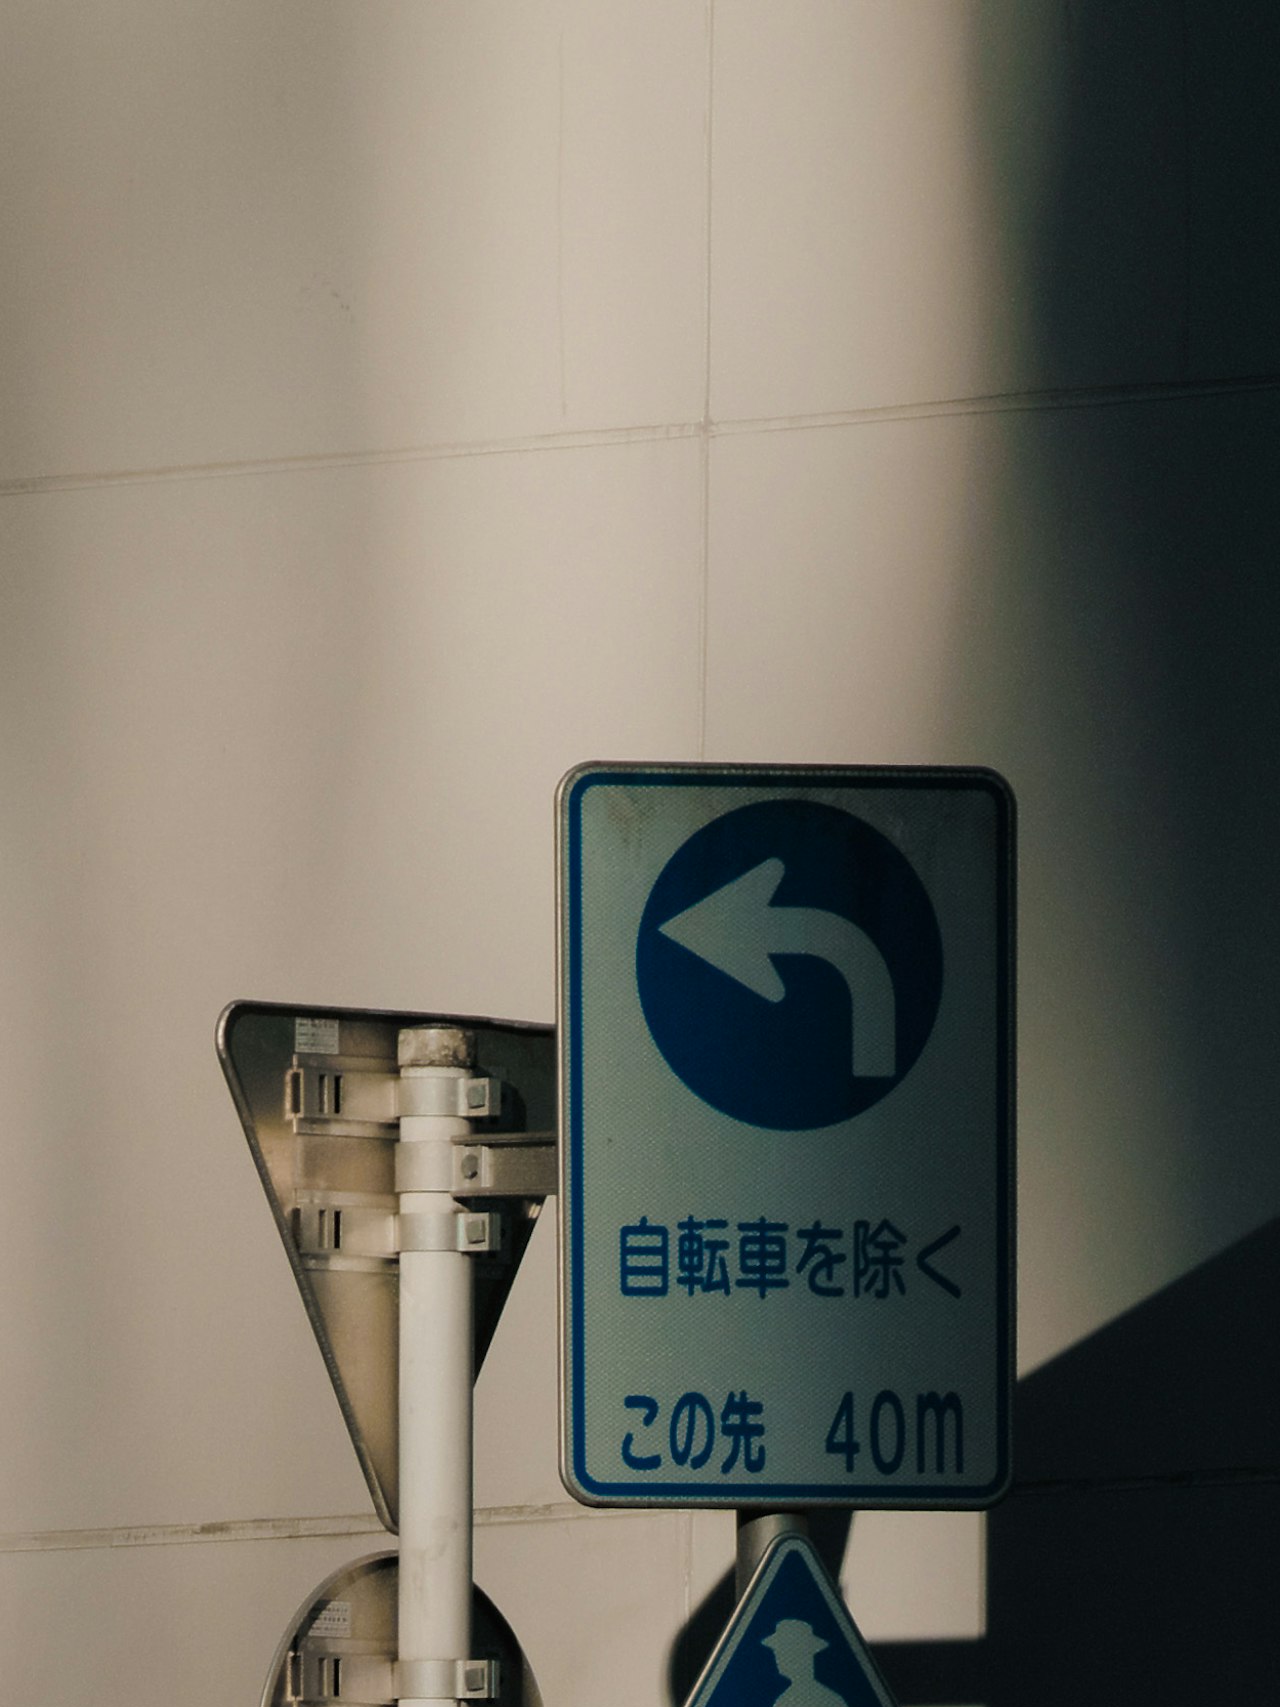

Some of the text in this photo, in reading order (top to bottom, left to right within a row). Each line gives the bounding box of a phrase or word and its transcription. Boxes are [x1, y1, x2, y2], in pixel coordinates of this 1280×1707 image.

[620, 1216, 961, 1299] 自転車を除く
[622, 1390, 964, 1475] この先 40m
